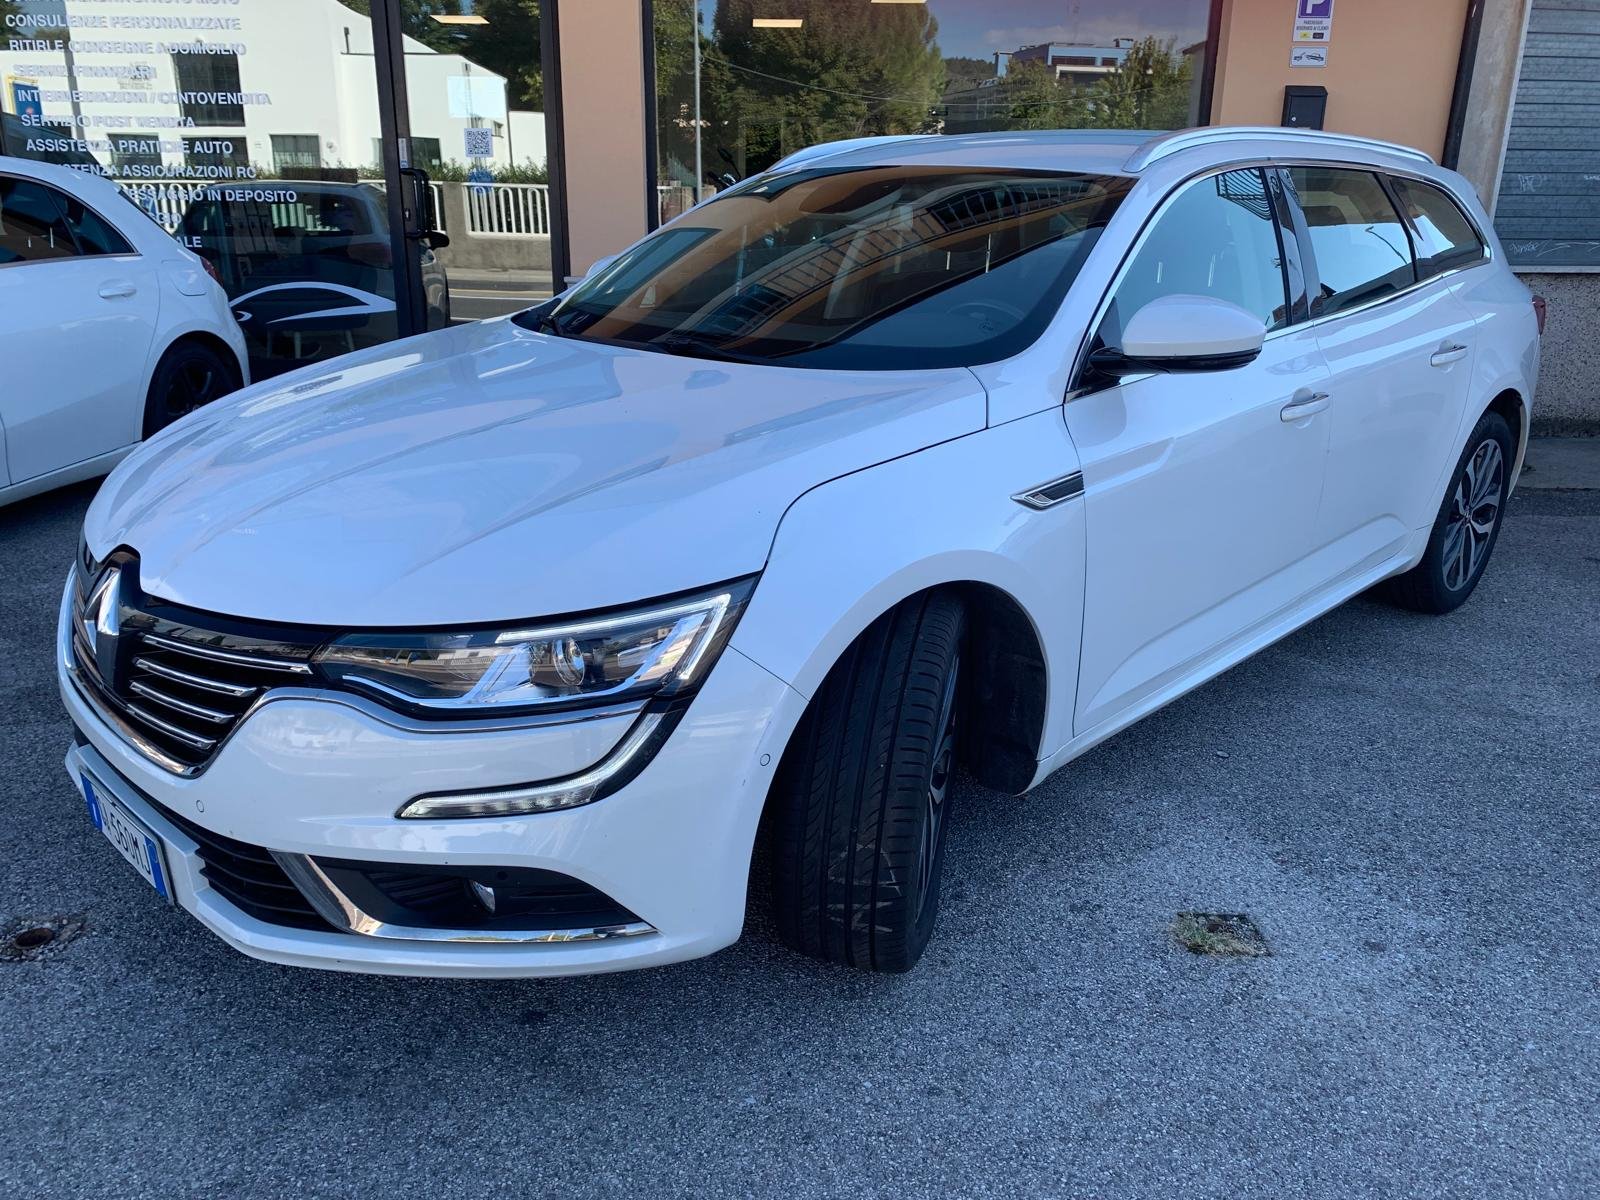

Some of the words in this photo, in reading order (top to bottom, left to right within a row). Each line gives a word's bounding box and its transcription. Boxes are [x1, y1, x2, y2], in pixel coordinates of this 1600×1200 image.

[5, 14, 108, 28] CONSULENZE
[111, 15, 242, 30] PERSONALIZZATE
[68, 41, 153, 54] CONSEGNE
[169, 42, 247, 55] DOMICILIO
[159, 91, 272, 105] CONTOVENDITA
[22, 114, 92, 127] SERVIZIO
[92, 116, 134, 128] POST
[136, 116, 196, 128] VENDITA
[26, 138, 116, 152] ASSISTENZA
[118, 140, 190, 153] PRATICHE
[193, 141, 233, 154] AUTO
[122, 164, 232, 178] ASSICURAZIONI
[207, 189, 222, 201] IN
[225, 189, 298, 202] DEPOSITO
